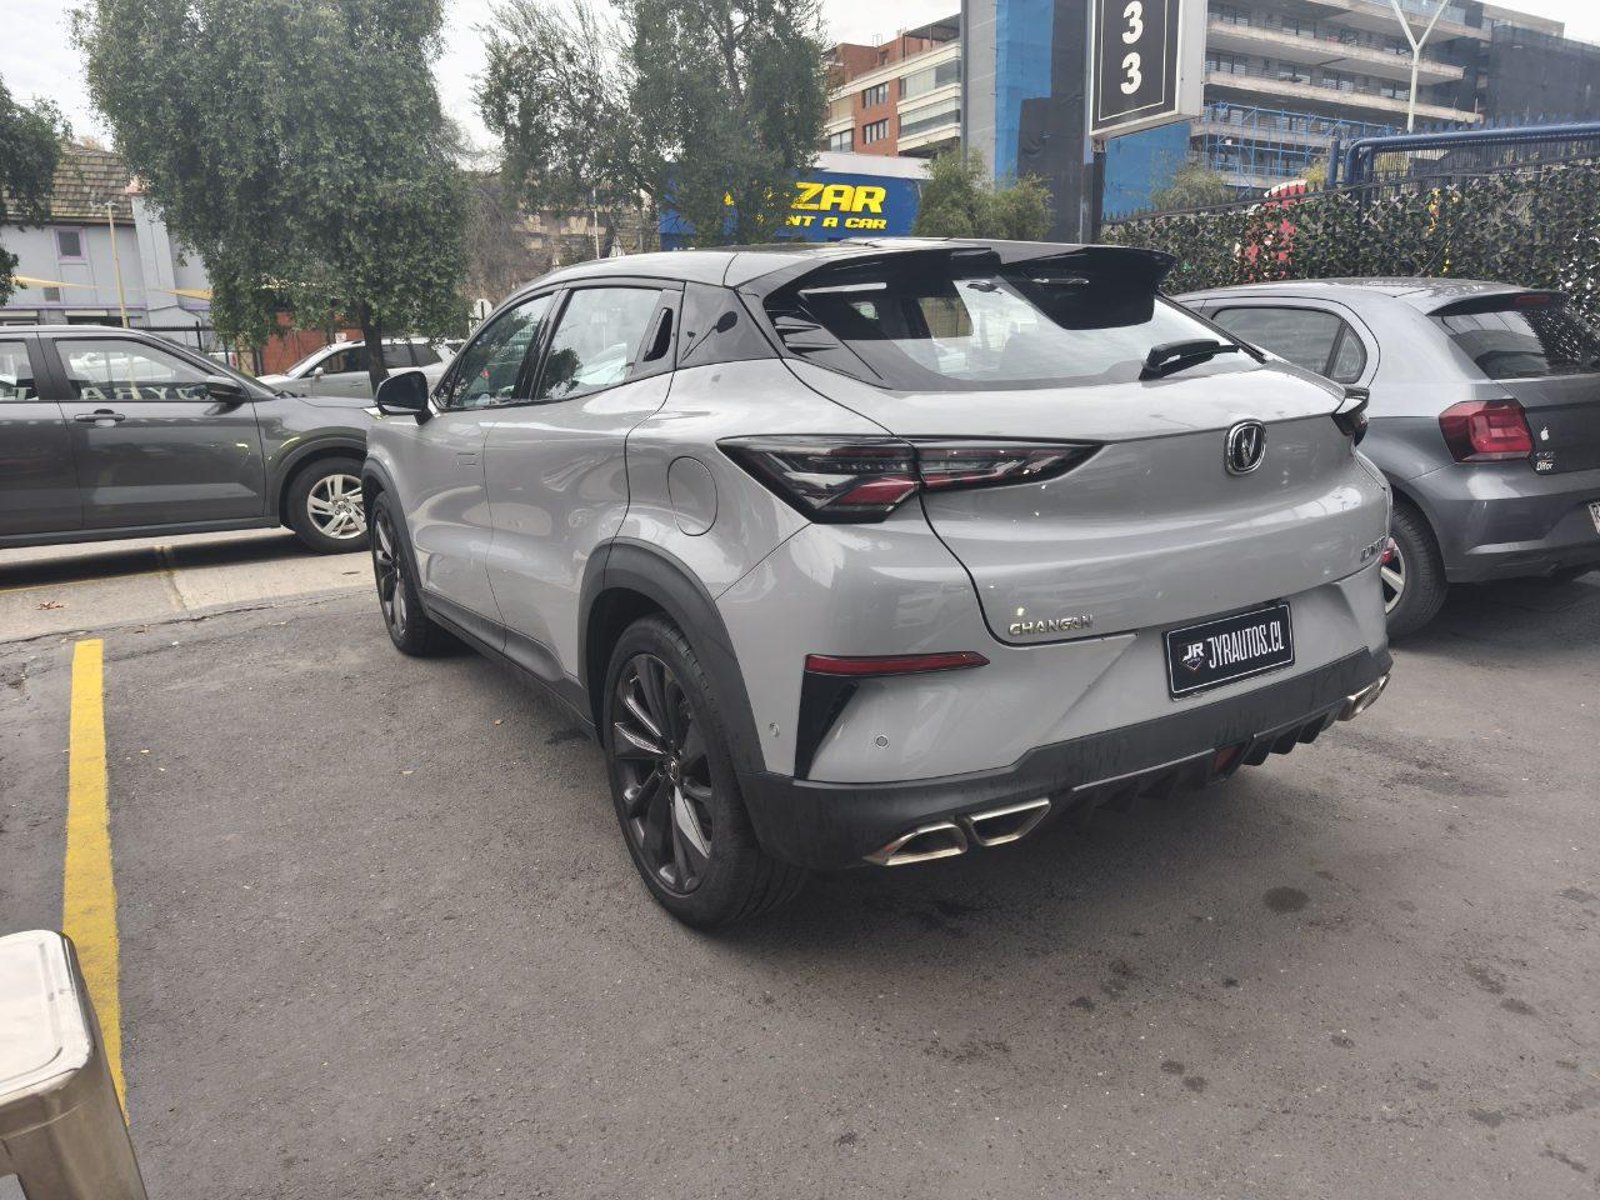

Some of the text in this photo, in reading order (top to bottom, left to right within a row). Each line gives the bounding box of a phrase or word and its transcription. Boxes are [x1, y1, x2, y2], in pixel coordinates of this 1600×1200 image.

[822, 216, 839, 228] A
[845, 217, 887, 230] CAR
[1182, 620, 1285, 669] JR JYRAUTOS.CL
